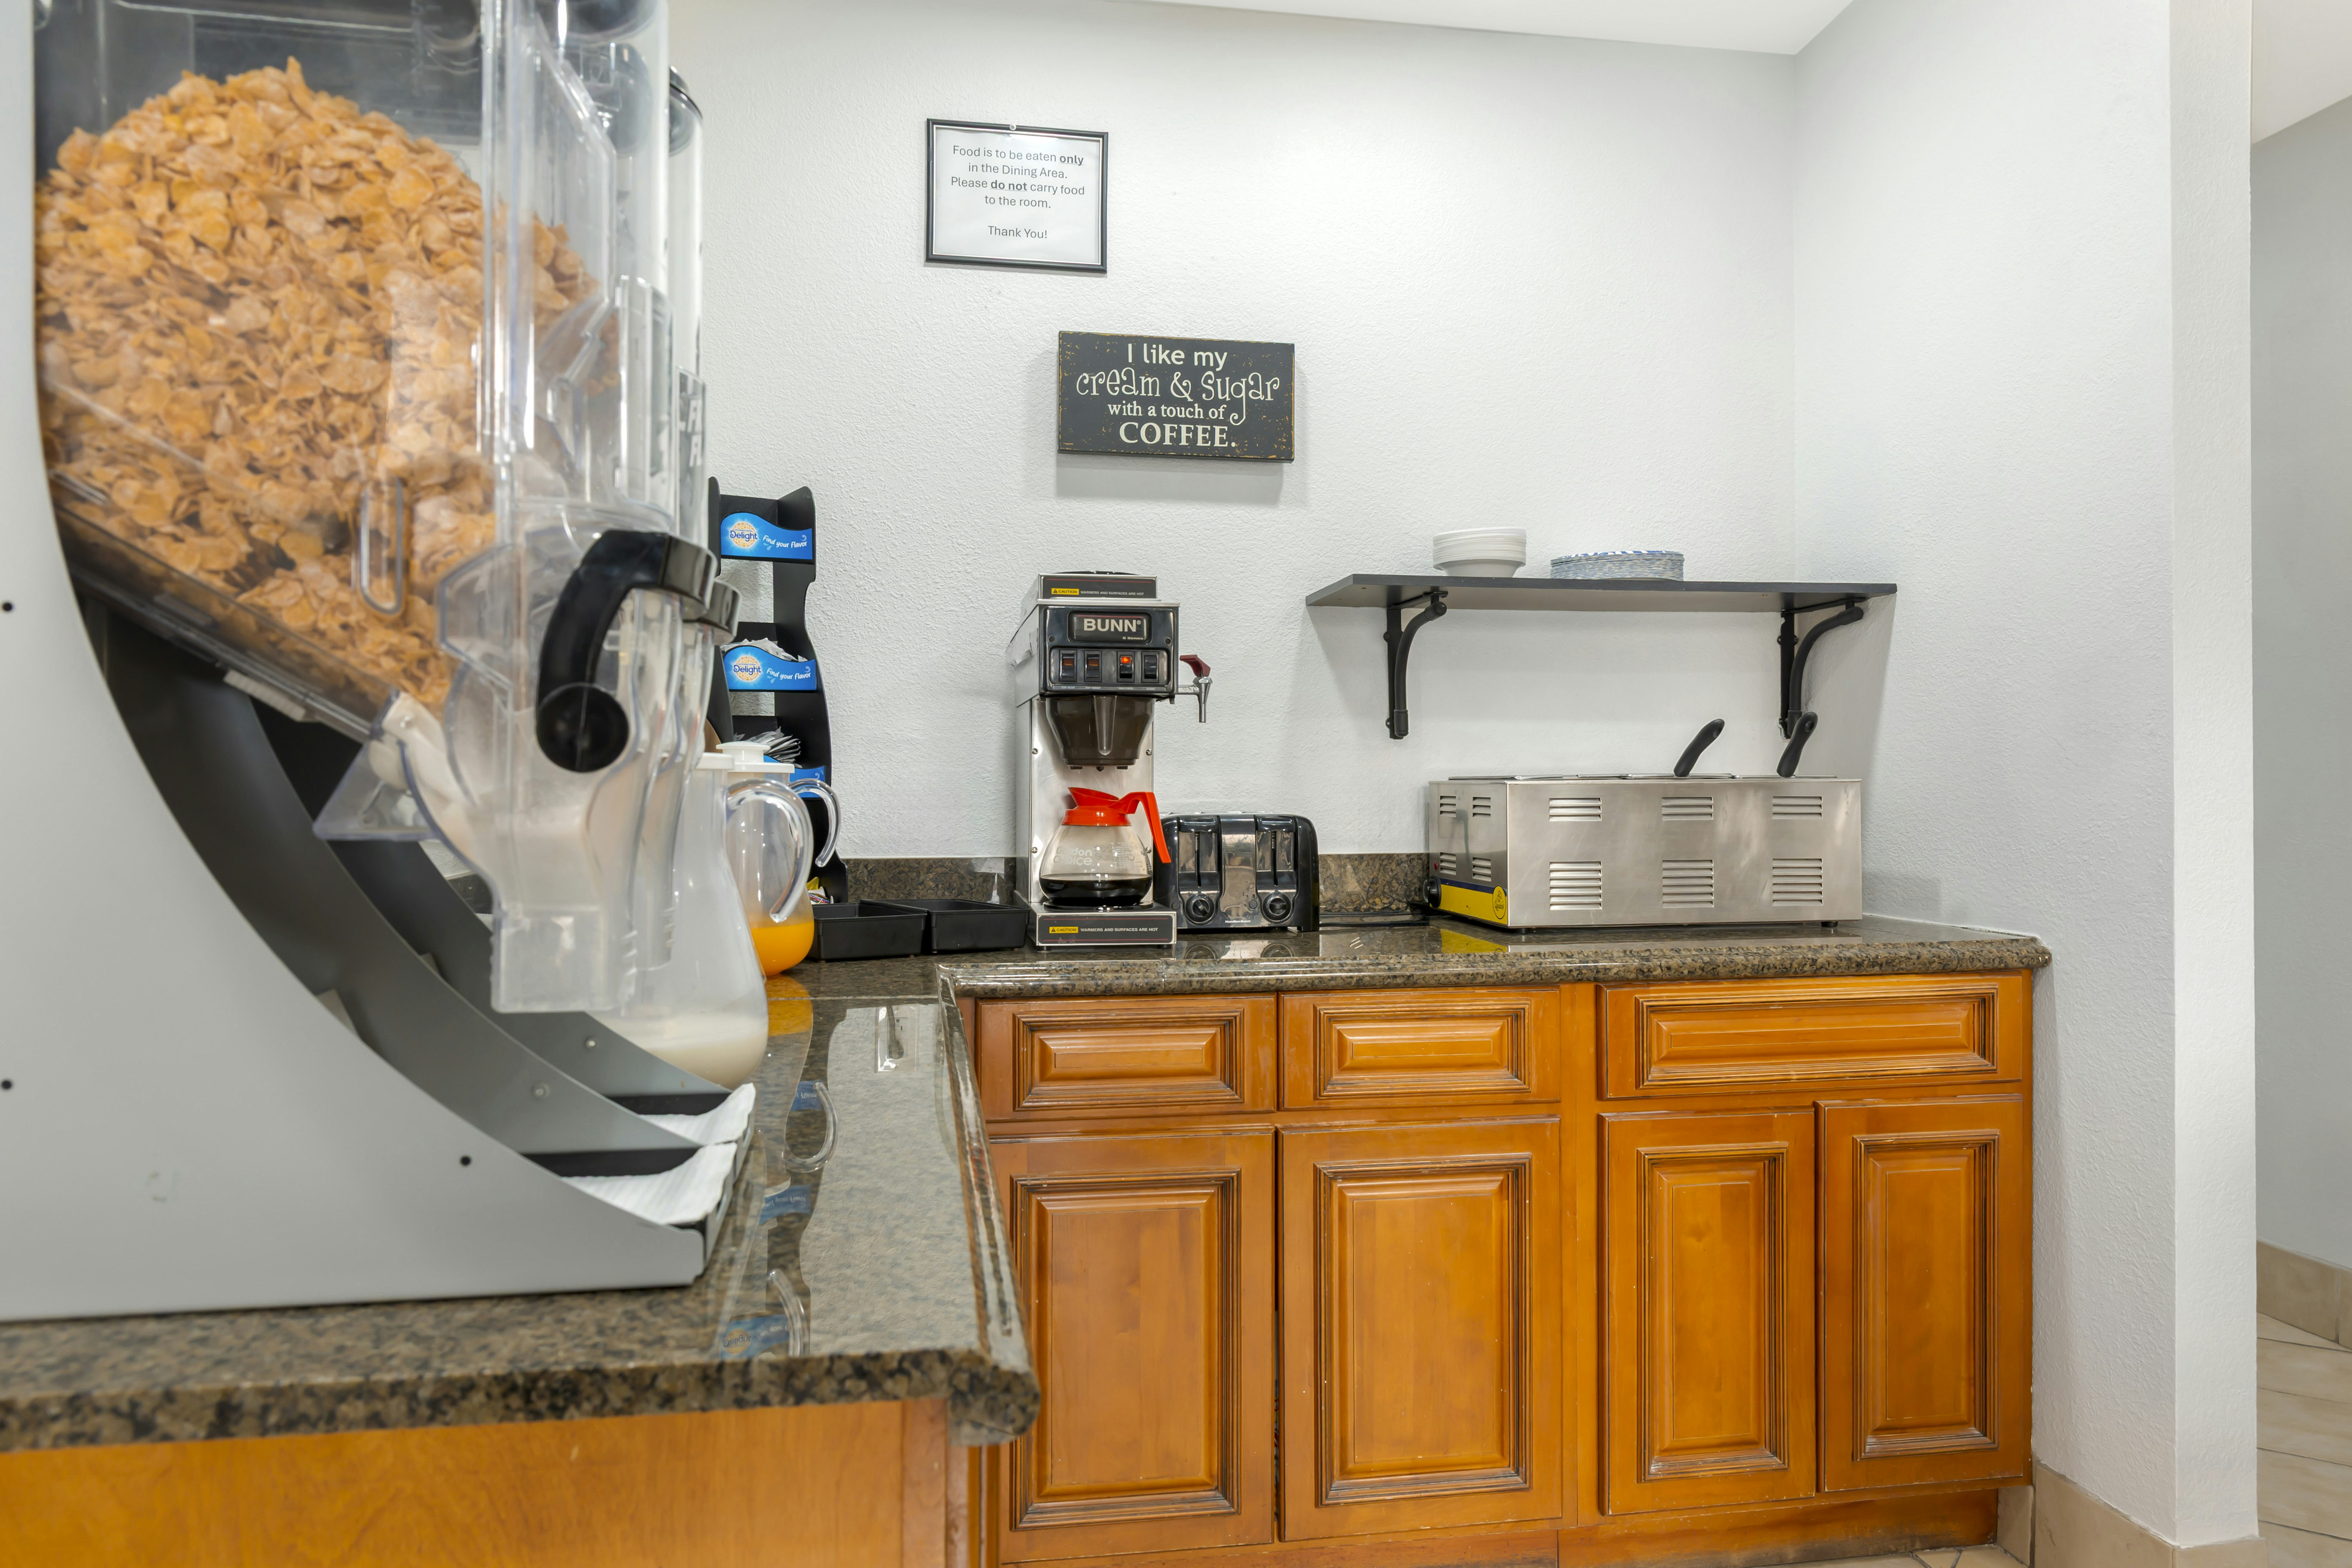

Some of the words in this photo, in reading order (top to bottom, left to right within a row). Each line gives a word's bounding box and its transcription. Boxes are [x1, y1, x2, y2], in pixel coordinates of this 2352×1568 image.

[953, 145, 980, 157] Food
[983, 147, 992, 157] is
[996, 149, 1006, 158] to
[1009, 150, 1022, 160] be
[1026, 152, 1056, 162] eaten
[1059, 155, 1084, 166] only
[969, 163, 978, 172] in
[981, 164, 999, 173] the
[1002, 165, 1037, 177] Dining
[1040, 167, 1067, 178] Area.
[951, 177, 988, 188] Please
[991, 180, 1005, 189] do
[1009, 182, 1027, 191] not
[1030, 184, 1057, 195] carry
[1060, 185, 1085, 195] food
[985, 195, 996, 204] to
[998, 196, 1016, 206] the
[1020, 199, 1051, 208] room.
[988, 226, 1021, 238] Thank
[1024, 229, 1047, 238] You!
[1128, 343, 1132, 363] I
[1143, 344, 1185, 365] like
[1194, 352, 1227, 371] my
[1076, 368, 1160, 396] cream
[1170, 372, 1193, 401] &
[1107, 400, 1142, 416] with
[1147, 405, 1156, 417] a
[1161, 403, 1204, 419] touch
[1209, 405, 1226, 419] of
[1119, 422, 1236, 448] COFFEE.
[730, 530, 758, 541] Delight
[763, 535, 776, 545] Find
[733, 665, 761, 675] Delight
[766, 668, 780, 677] Find
